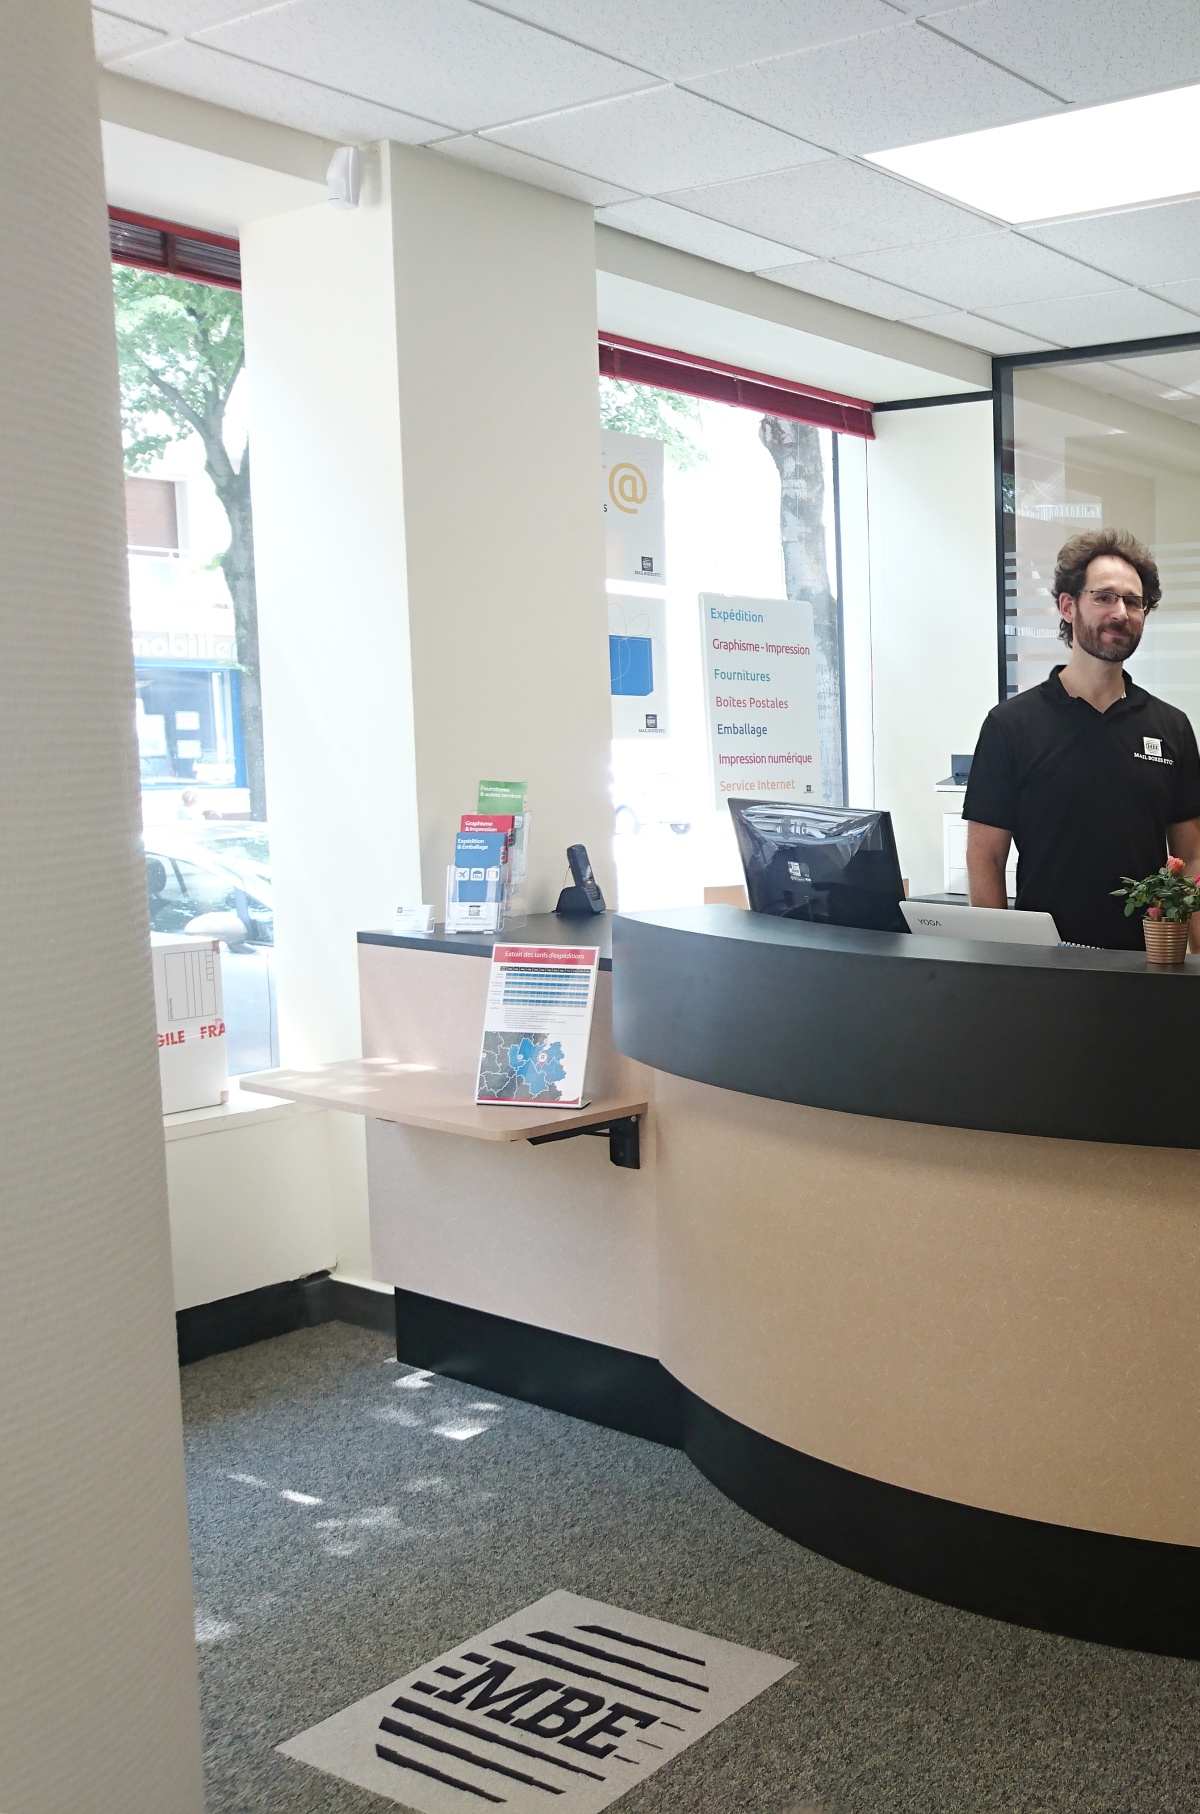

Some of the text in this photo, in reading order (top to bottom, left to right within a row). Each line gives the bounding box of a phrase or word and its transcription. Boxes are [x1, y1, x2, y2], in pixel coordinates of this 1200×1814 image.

[710, 608, 764, 623] Expédition
[712, 638, 760, 652] Graphisme
[765, 642, 810, 655] Impression
[714, 668, 771, 681] Fournitures
[715, 696, 789, 709] Boîtes Postales
[717, 723, 768, 737] Emballage
[718, 751, 813, 767] Impression numérique
[480, 785, 510, 793] Fournitures
[720, 780, 755, 792] Service
[757, 779, 796, 790] Internet
[793, 822, 807, 836] LG
[917, 918, 942, 927] YOGA
[505, 950, 523, 958] Extrait
[433, 1659, 661, 1760] MBE
